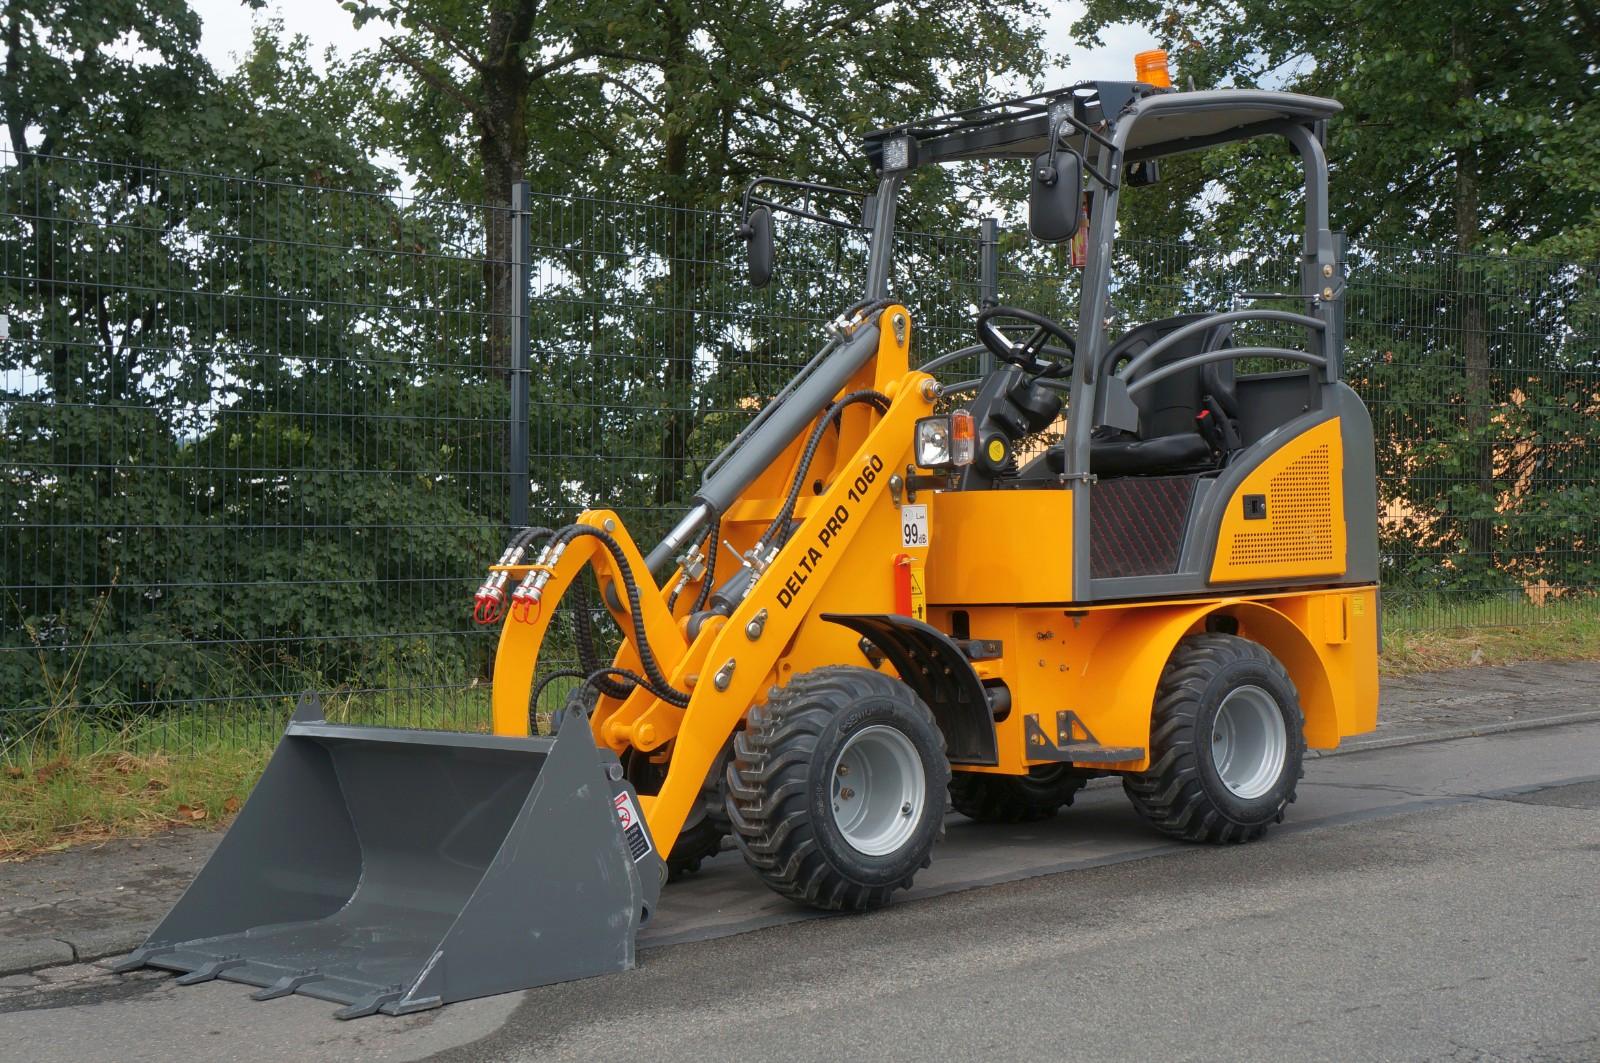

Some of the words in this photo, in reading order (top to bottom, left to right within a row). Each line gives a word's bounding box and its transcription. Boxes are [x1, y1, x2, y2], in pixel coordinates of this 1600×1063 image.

[776, 547, 823, 608] DELTA
[818, 505, 849, 548] PRO
[848, 455, 883, 502] 1060
[904, 523, 918, 544] 99
